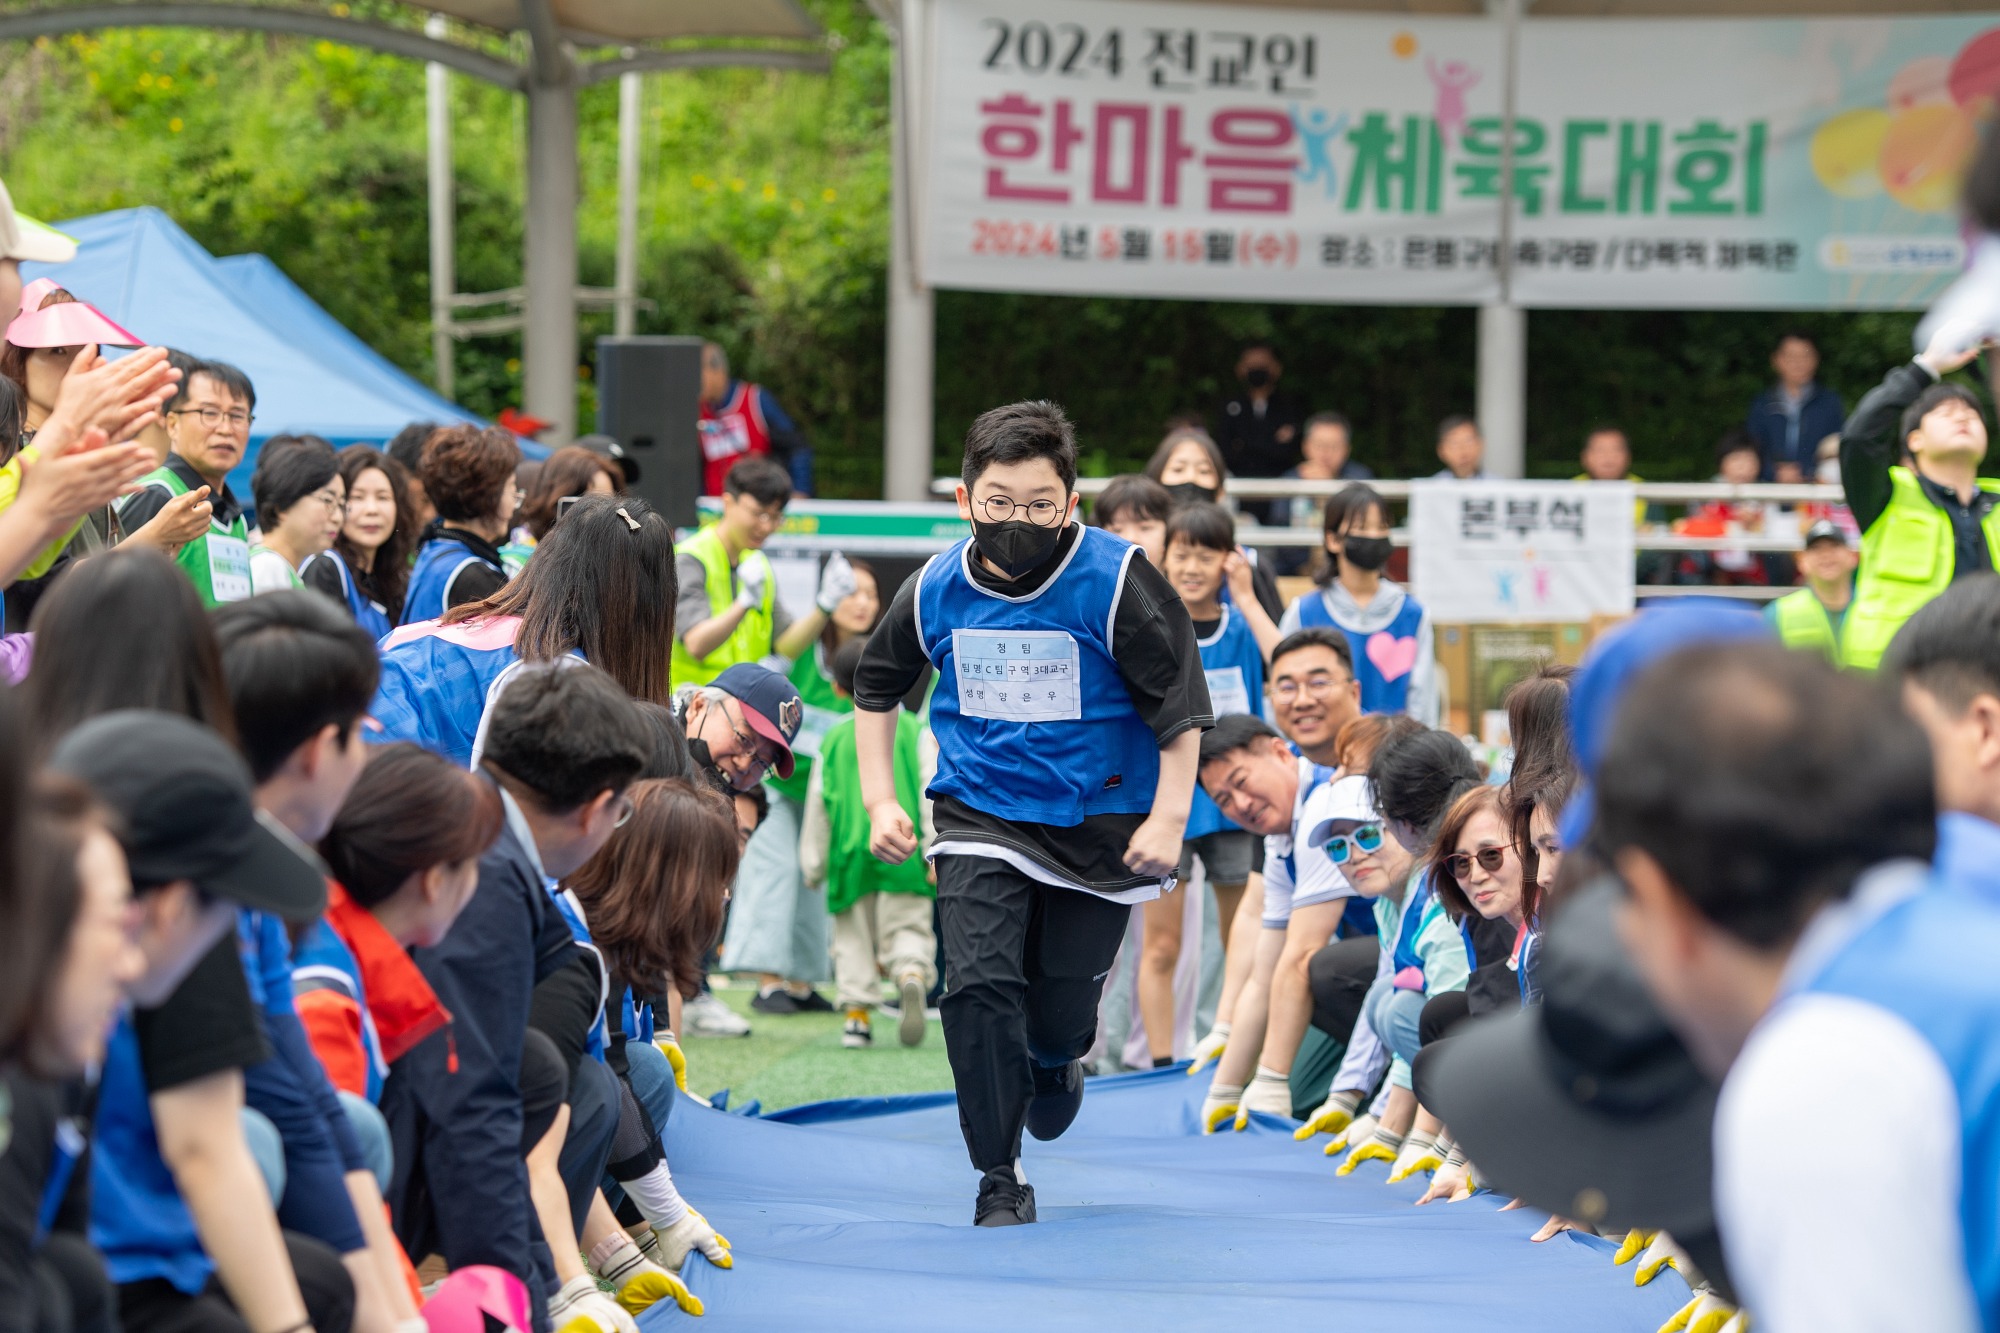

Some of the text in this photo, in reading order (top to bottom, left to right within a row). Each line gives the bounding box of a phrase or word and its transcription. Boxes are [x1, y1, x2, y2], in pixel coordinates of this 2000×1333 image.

[981, 18, 1317, 95] 2024 전교인
[979, 93, 1769, 217] 한마음 체육대회
[970, 219, 1088, 261] 2024년
[1097, 226, 1152, 261] 5월
[1462, 497, 1585, 540] 본부석
[1034, 664, 1069, 675] 3대교구
